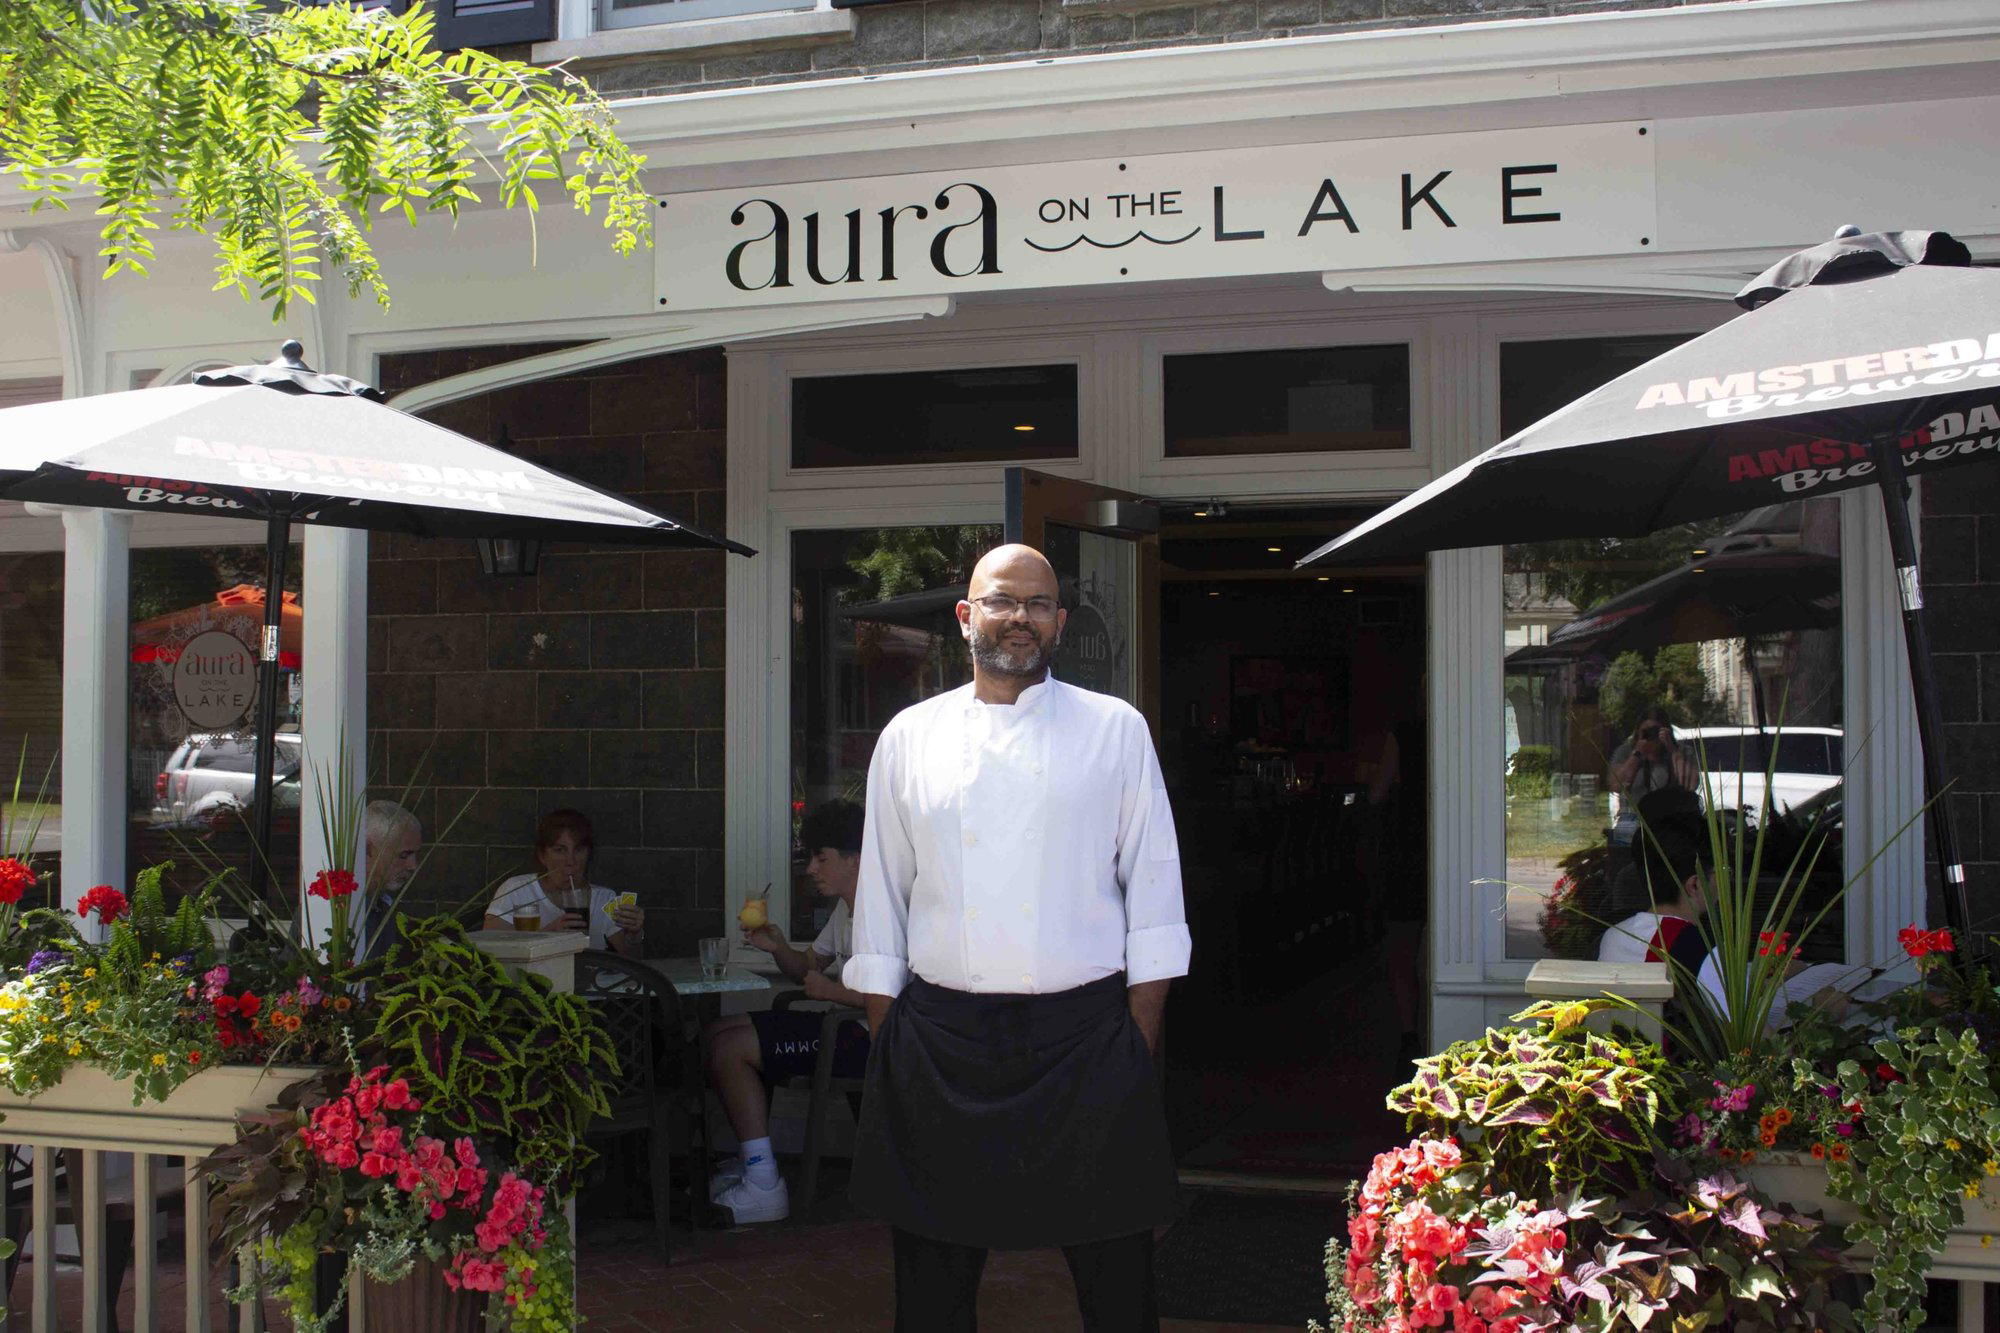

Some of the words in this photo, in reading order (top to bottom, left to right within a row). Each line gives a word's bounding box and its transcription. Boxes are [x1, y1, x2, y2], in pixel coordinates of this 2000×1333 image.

[726, 183, 1002, 290] aura
[1039, 198, 1089, 223] ON
[1107, 190, 1182, 217] THE
[1213, 164, 1560, 241] LAKE
[174, 436, 535, 491] AMSTERDAM
[122, 487, 244, 509] Brew
[185, 651, 245, 676] aura
[185, 694, 244, 708] LAKE
[775, 1039, 819, 1055] OMMY
